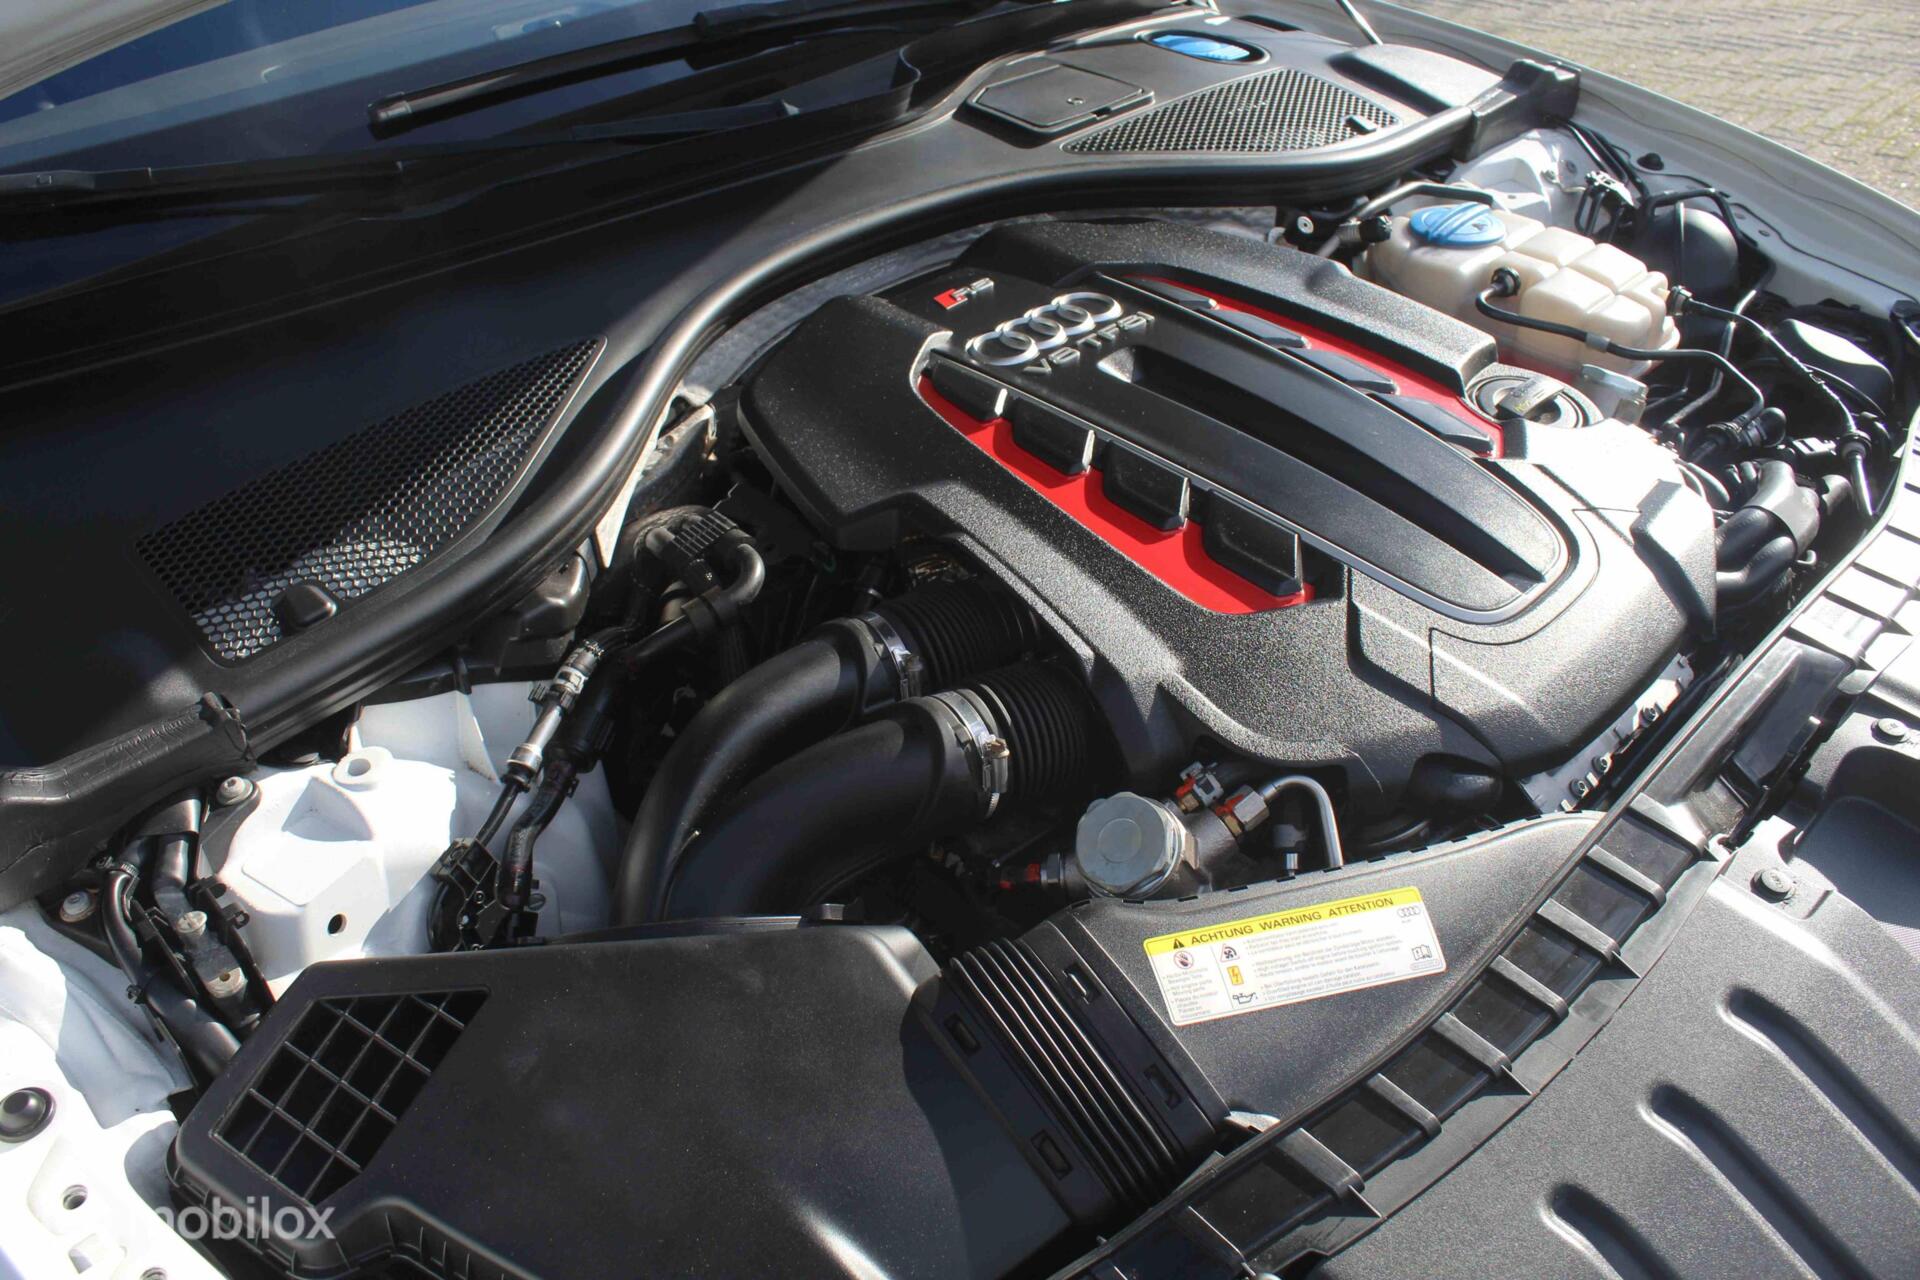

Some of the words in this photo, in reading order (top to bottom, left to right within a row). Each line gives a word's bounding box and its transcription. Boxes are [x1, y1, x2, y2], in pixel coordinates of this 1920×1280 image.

[1022, 347, 1081, 375] V8
[1076, 310, 1155, 348] TFSI
[1190, 924, 1254, 946] ACHTUNG
[1259, 911, 1323, 932] WARNING
[1328, 897, 1394, 918] ATTENTION
